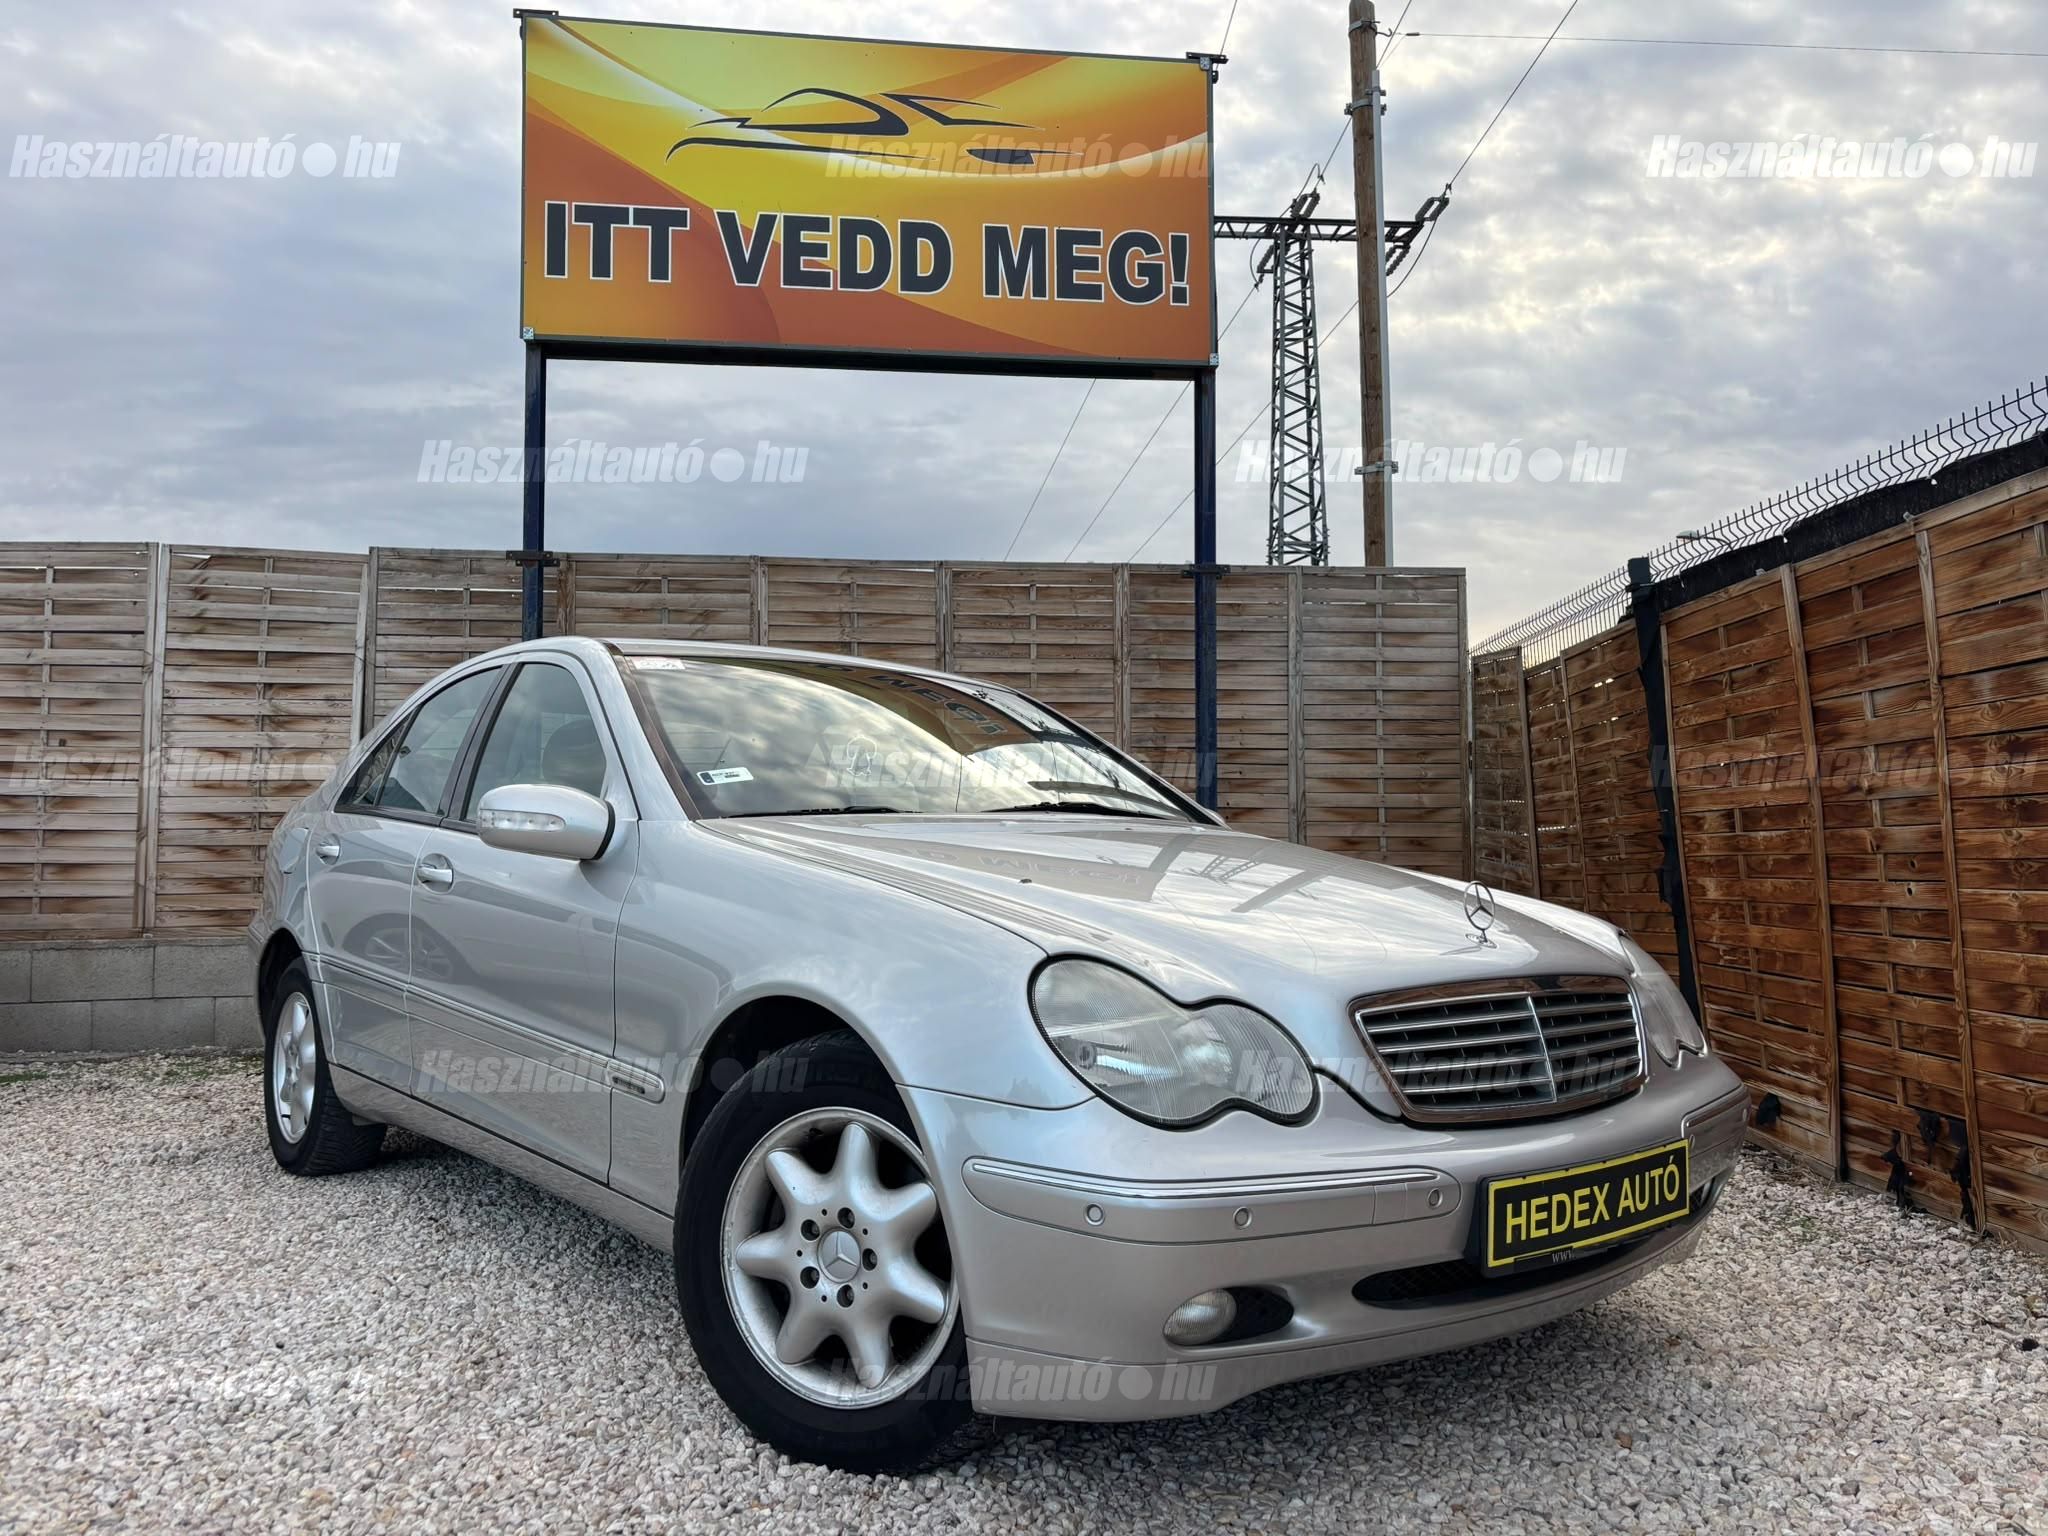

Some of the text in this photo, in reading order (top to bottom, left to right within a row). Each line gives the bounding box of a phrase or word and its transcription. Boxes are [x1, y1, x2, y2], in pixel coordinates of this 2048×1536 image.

[544, 200, 1190, 307] ITT VEDD MEG!
[1506, 1155, 1680, 1244] HEDEX AUTÓ
